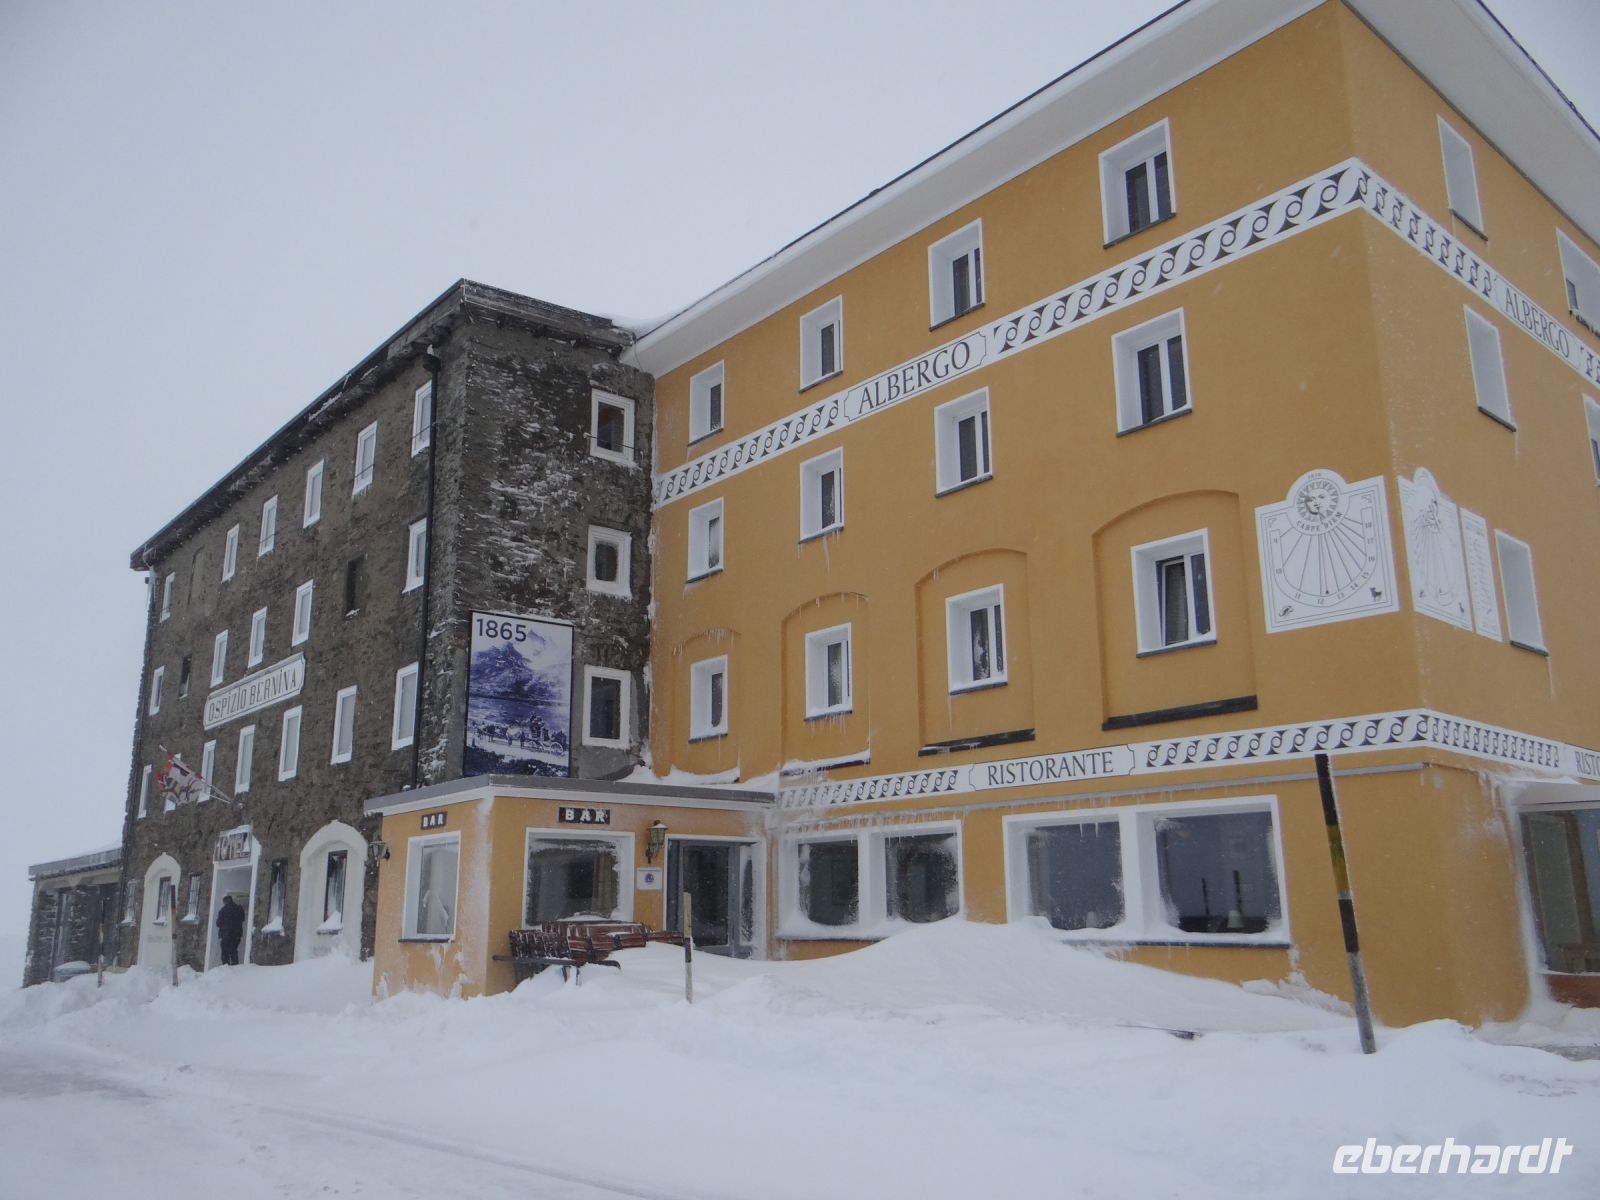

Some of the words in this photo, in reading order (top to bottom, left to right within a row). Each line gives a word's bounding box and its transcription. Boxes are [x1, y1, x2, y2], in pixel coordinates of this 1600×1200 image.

[1505, 287, 1570, 359] ALBERGO
[858, 341, 970, 414] ALBERGO
[1296, 520, 1320, 532] CARPE
[1324, 511, 1343, 529] DIEM
[476, 618, 527, 642] 1865
[208, 687, 247, 721] OSPIZIO
[249, 668, 297, 706] BERNINA
[987, 751, 1114, 786] RISTORANTE
[423, 813, 444, 828] BAR
[565, 808, 607, 823] BAR
